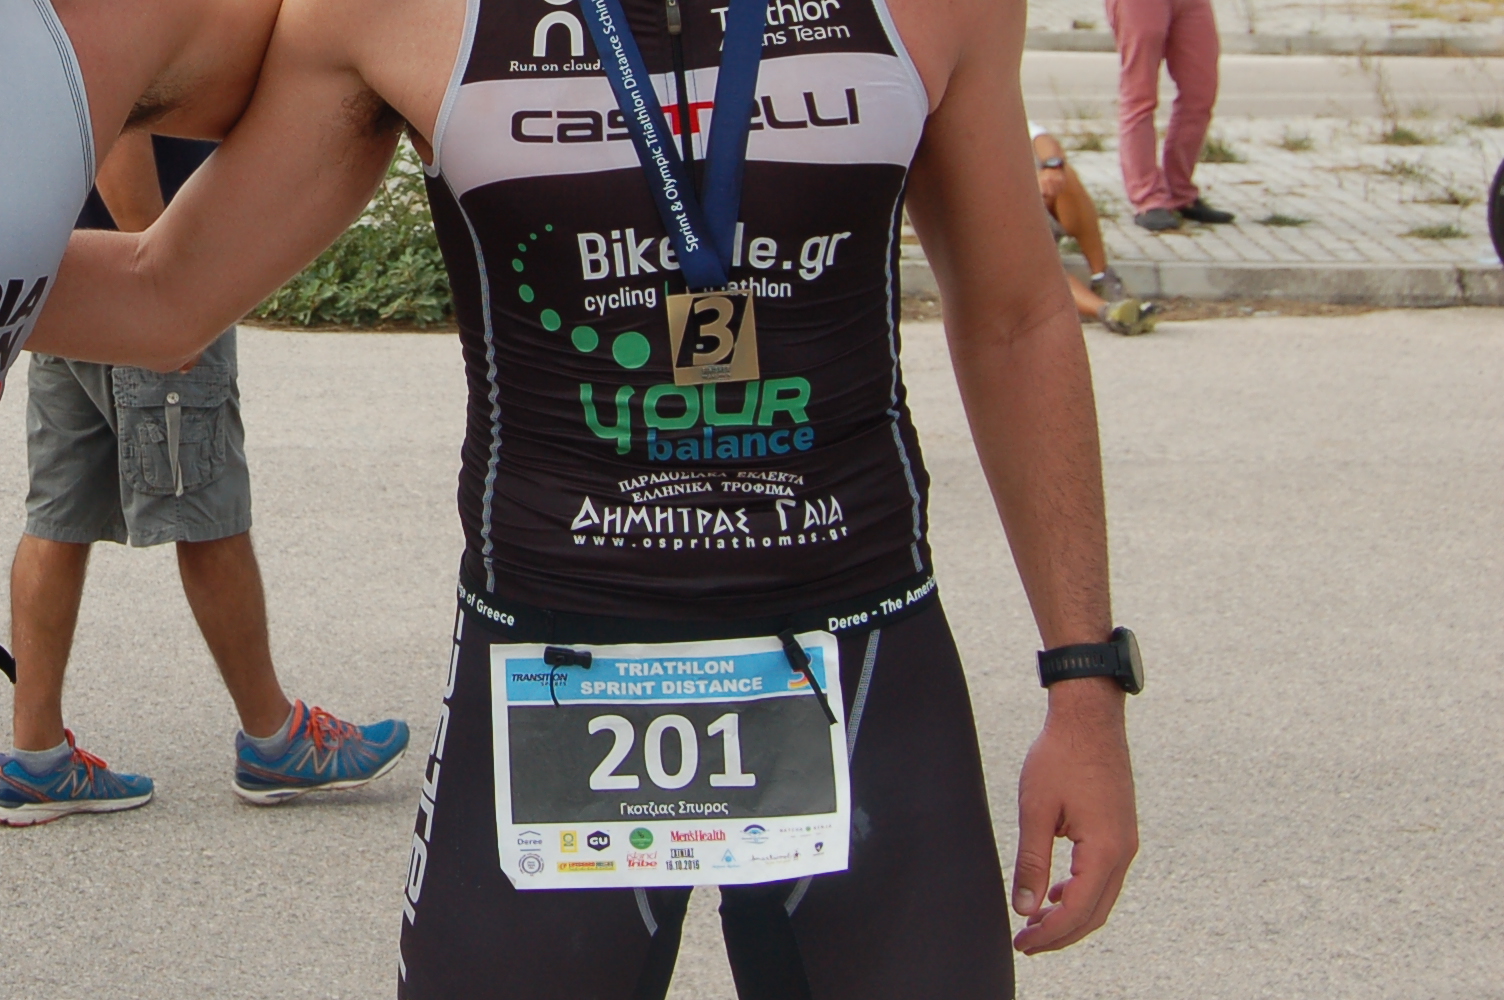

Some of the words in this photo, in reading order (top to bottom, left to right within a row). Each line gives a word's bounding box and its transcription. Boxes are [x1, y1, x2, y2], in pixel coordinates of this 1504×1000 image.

[788, 25, 851, 42] Team
[509, 61, 537, 71] Run
[541, 63, 558, 71] on
[609, 35, 637, 89] Distance
[631, 90, 658, 147] Triathlon
[652, 146, 679, 200] Olympic
[671, 200, 684, 213] &
[676, 215, 699, 253] Sprint
[584, 286, 657, 316] cycling
[693, 296, 734, 366] 3
[647, 426, 814, 461] balance
[631, 482, 713, 503] ΕΛΛΗΝΙΚΑ
[721, 481, 795, 497] ΤΡΟΦΙΜΑ
[476, 599, 515, 626] Greece
[828, 612, 868, 631] Deree
[880, 598, 903, 615] The
[512, 673, 568, 682] TRANSITON
[615, 660, 734, 677] TRIATHLON
[580, 681, 656, 696] SPRINT
[662, 676, 763, 694] DISTANCE
[588, 713, 756, 791] 201
[620, 802, 675, 817] Γκοτζιας
[678, 801, 729, 815] Σπυρος
[589, 836, 608, 846] GU
